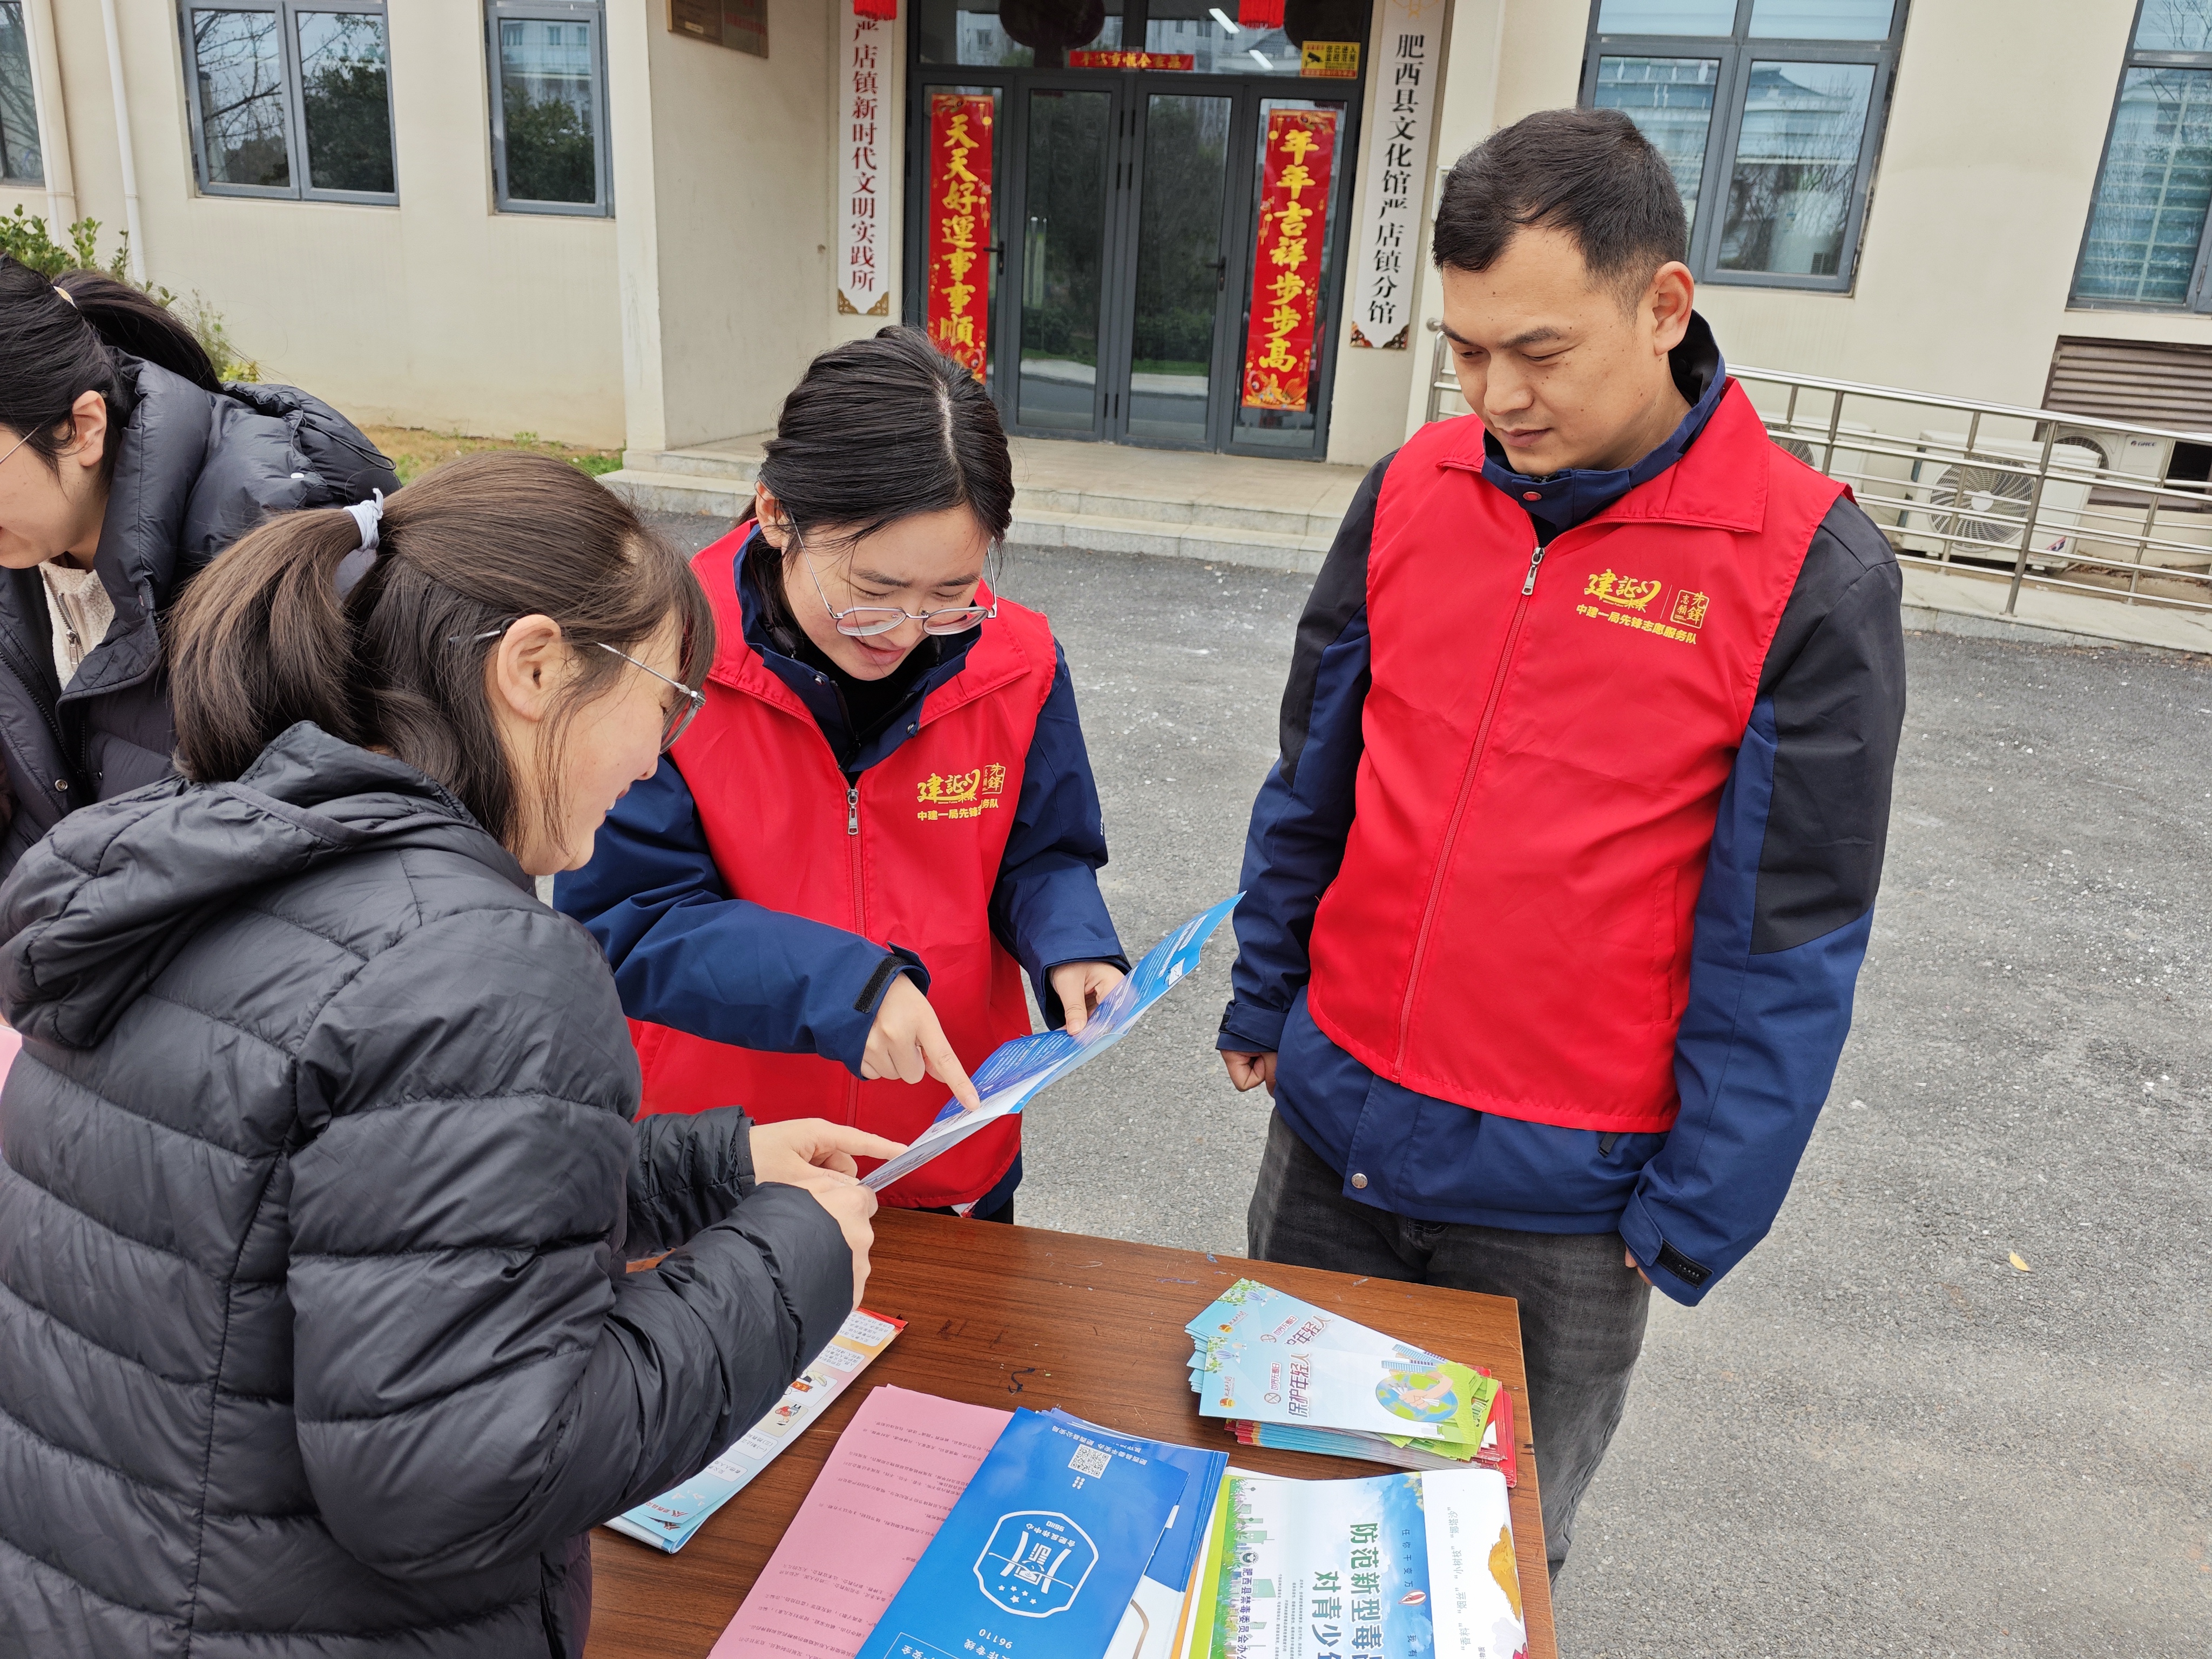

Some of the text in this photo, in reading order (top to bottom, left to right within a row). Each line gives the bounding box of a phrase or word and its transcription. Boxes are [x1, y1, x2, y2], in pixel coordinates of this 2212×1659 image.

[851, 20, 880, 292] 严店镇新时代文明实践所
[1367, 34, 1425, 325] 肥西县文化馆严店镇分馆
[1259, 129, 1320, 373] 年年吉祥步步高
[1576, 604, 1697, 645] 中建一局先锋志愿服务队
[1288, 1353, 1309, 1417] 保护年轻人
[1051, 1426, 1095, 1448] 肥西县公安局
[1026, 1522, 1076, 1548] 合肥反诈中心
[979, 1628, 1013, 1649] 96110
